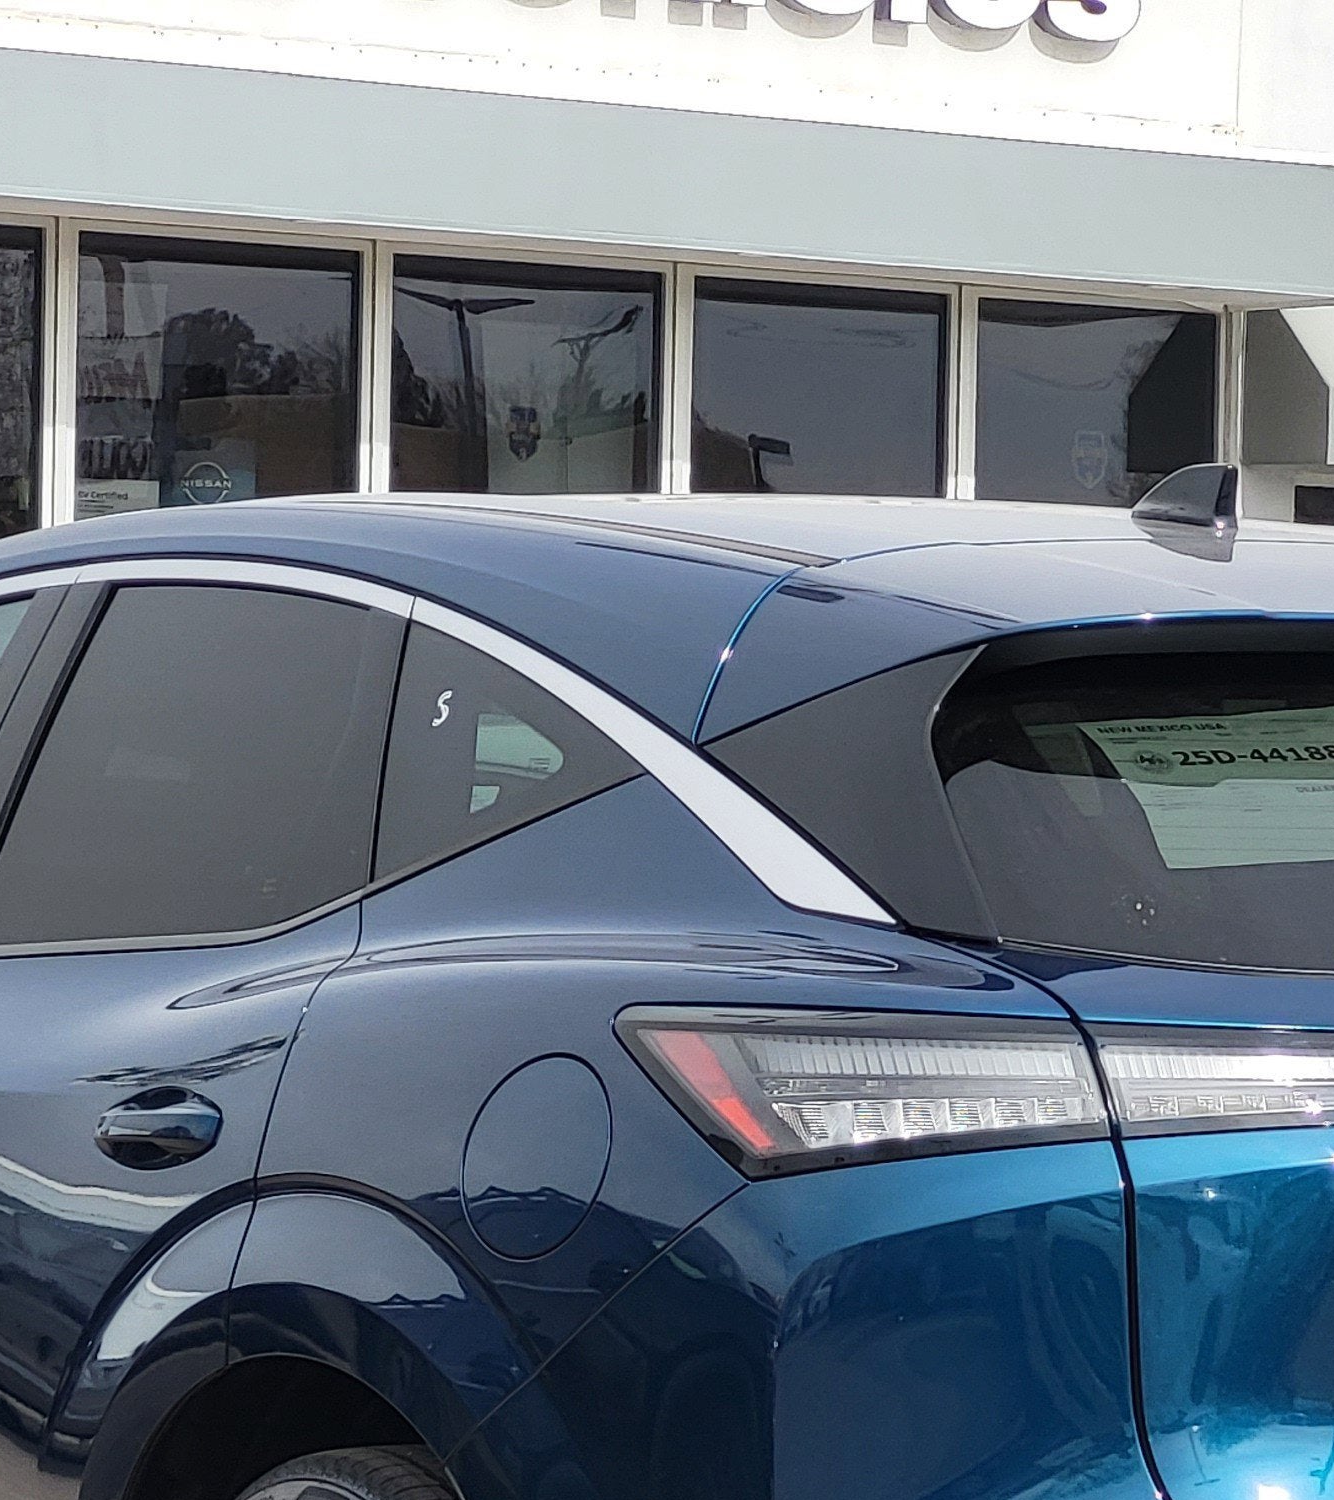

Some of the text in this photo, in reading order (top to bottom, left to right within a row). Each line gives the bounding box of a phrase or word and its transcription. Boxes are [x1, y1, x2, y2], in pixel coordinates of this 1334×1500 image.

[180, 479, 232, 489] NISSAN
[1097, 722, 1228, 735] NEW MEXICO USA
